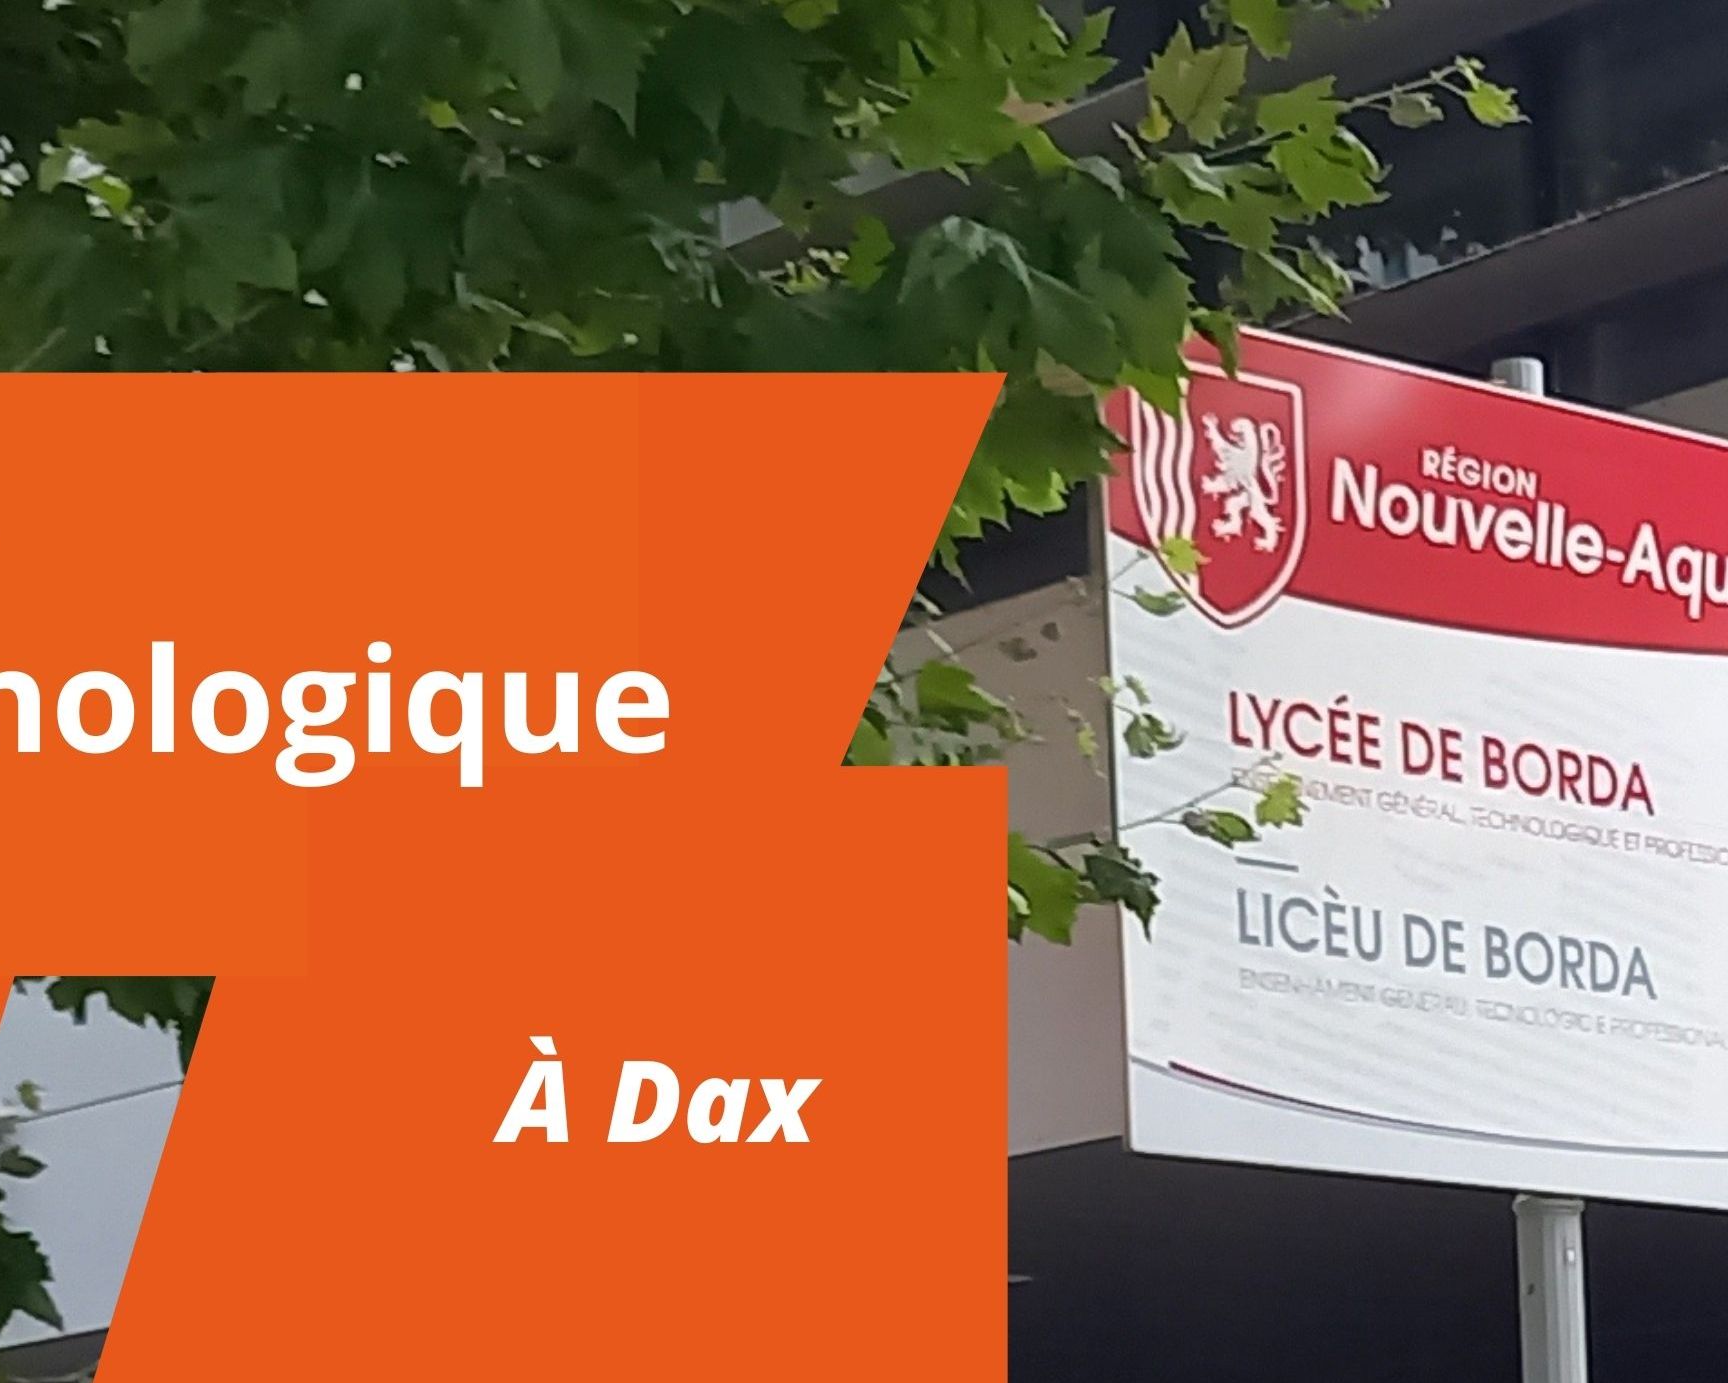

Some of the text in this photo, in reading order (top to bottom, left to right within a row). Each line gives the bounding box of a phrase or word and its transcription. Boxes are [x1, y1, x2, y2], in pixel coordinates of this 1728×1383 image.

[1422, 444, 1539, 499] RÉGION
[1229, 691, 1656, 817] LYCÉE DE BORDA
[1236, 884, 1659, 1001] LICÈU DE BORDA
